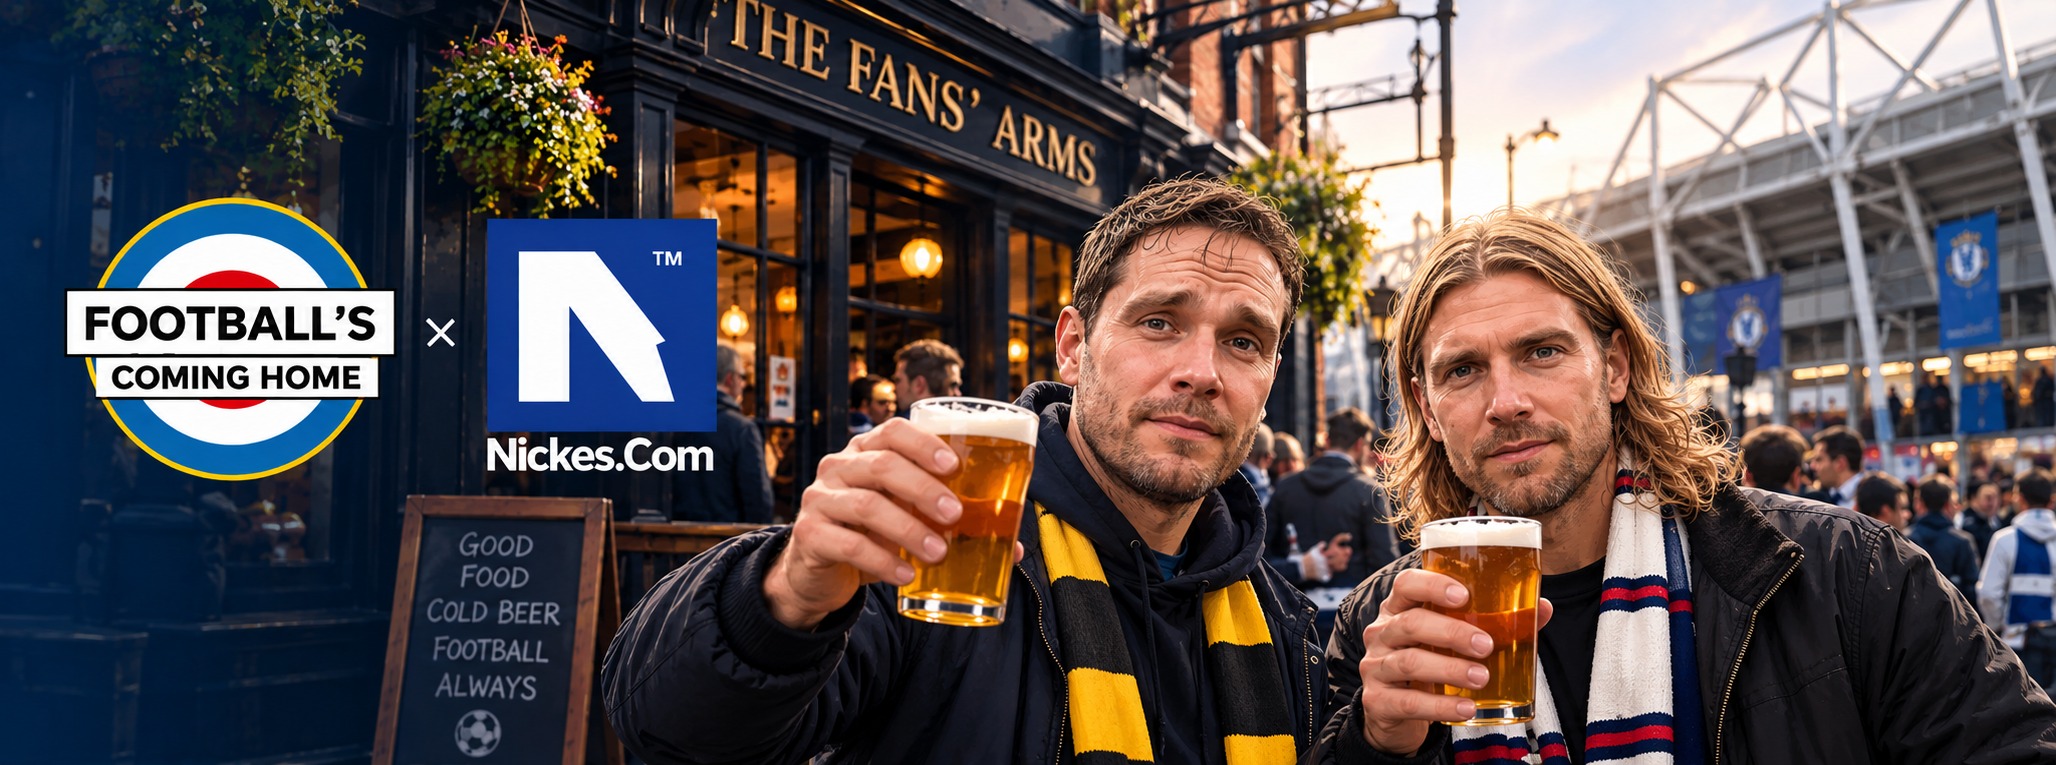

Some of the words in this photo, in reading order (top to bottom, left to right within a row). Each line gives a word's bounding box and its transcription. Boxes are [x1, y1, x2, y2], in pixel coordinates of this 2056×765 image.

[723, 0, 830, 80] THE
[992, 105, 1097, 188] ARMS
[459, 531, 534, 558] GOOD
[460, 564, 530, 589] FOOD
[427, 598, 488, 623] COLD
[498, 599, 561, 626] BEER
[433, 635, 549, 664] FOOTBALL
[435, 672, 537, 701] ALWAYS
